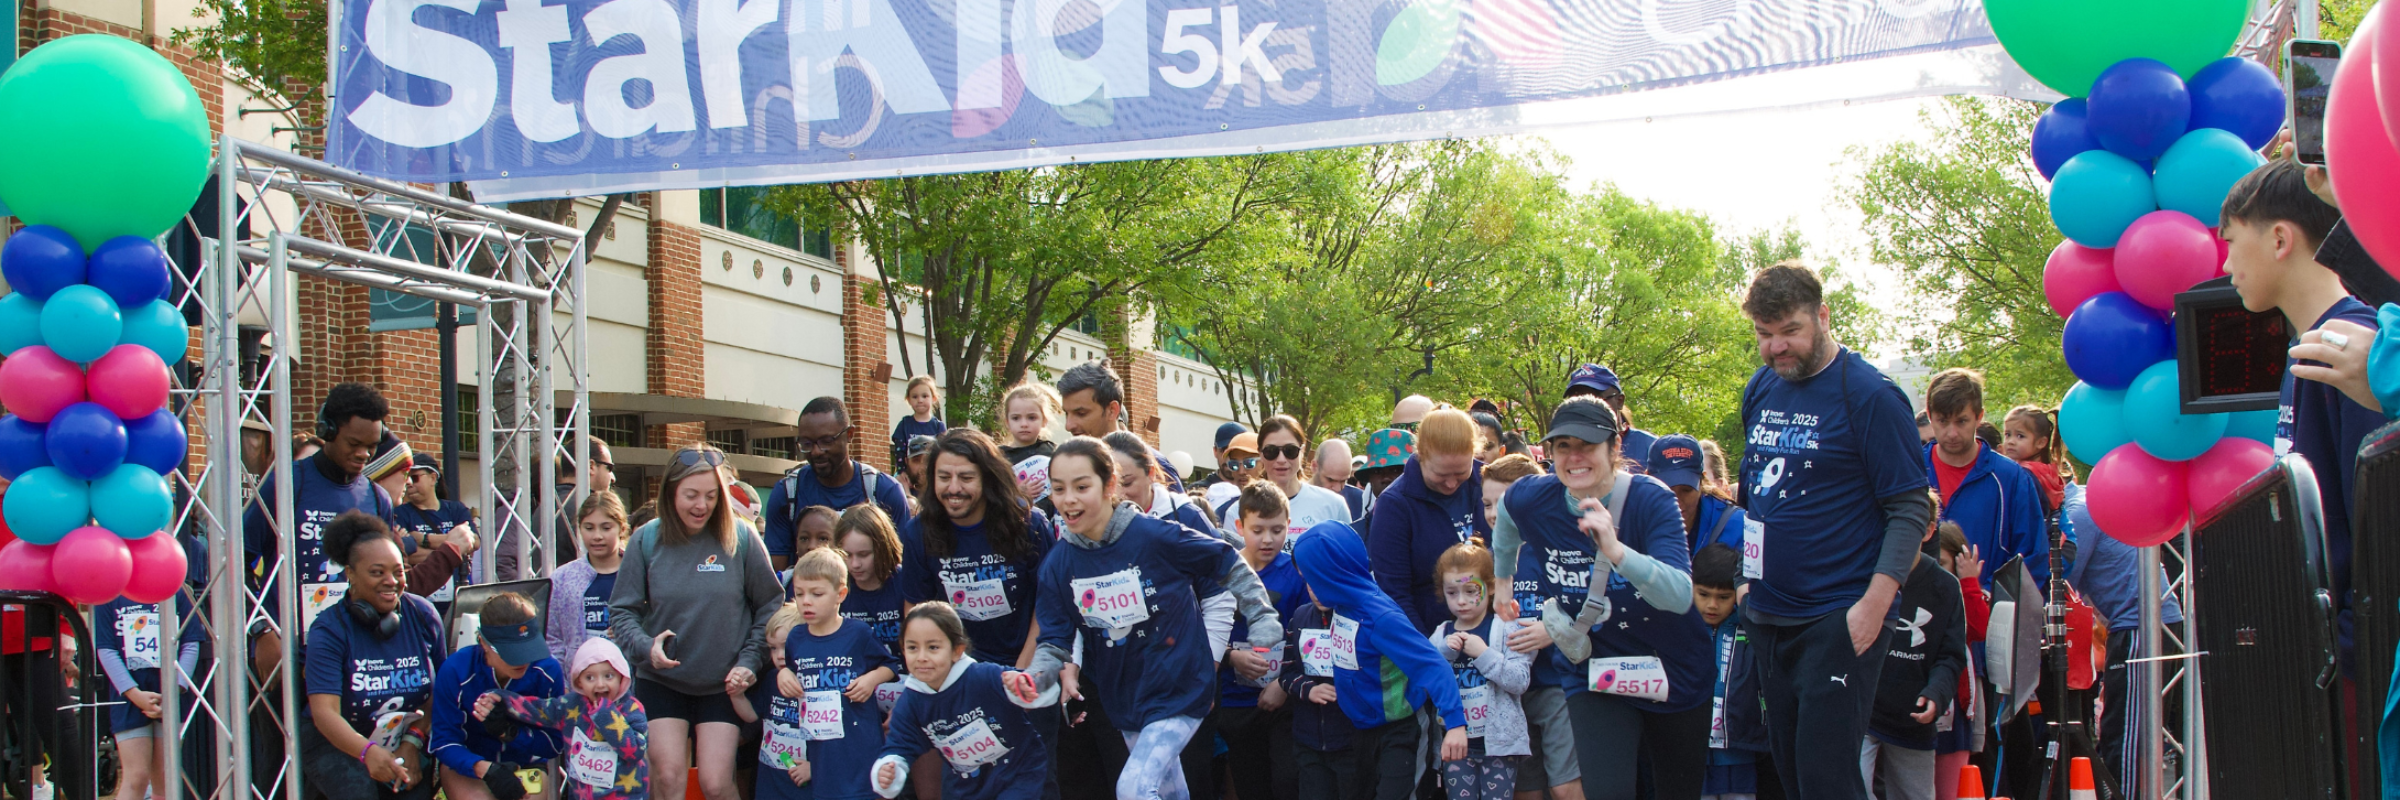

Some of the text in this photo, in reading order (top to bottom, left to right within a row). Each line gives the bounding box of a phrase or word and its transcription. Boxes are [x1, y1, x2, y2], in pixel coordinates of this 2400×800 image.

[1158, 5, 1282, 89] 5k
[1791, 412, 1819, 426] 2025
[1749, 423, 1811, 449] StarKid
[1744, 541, 1759, 559] 20
[981, 553, 1006, 565] 2025
[1095, 576, 1126, 590] StarKid
[1513, 581, 1538, 592] 2025
[967, 594, 1005, 608] 5102
[1098, 591, 1138, 612] 5101
[877, 610, 900, 621] 2025
[135, 637, 158, 652] 54
[1332, 633, 1353, 654] 5513
[1314, 646, 1331, 660] 55
[396, 656, 420, 668] 2025
[826, 656, 853, 667] 2025
[1620, 661, 1657, 671] StarKid
[351, 669, 422, 691] StarKid
[1616, 679, 1663, 694] 5517
[807, 709, 838, 723] 5242
[957, 706, 984, 724] 2025
[1464, 705, 1488, 722] 136
[771, 740, 801, 757] 5241
[956, 736, 995, 760] 5104
[579, 753, 613, 773] 5462
